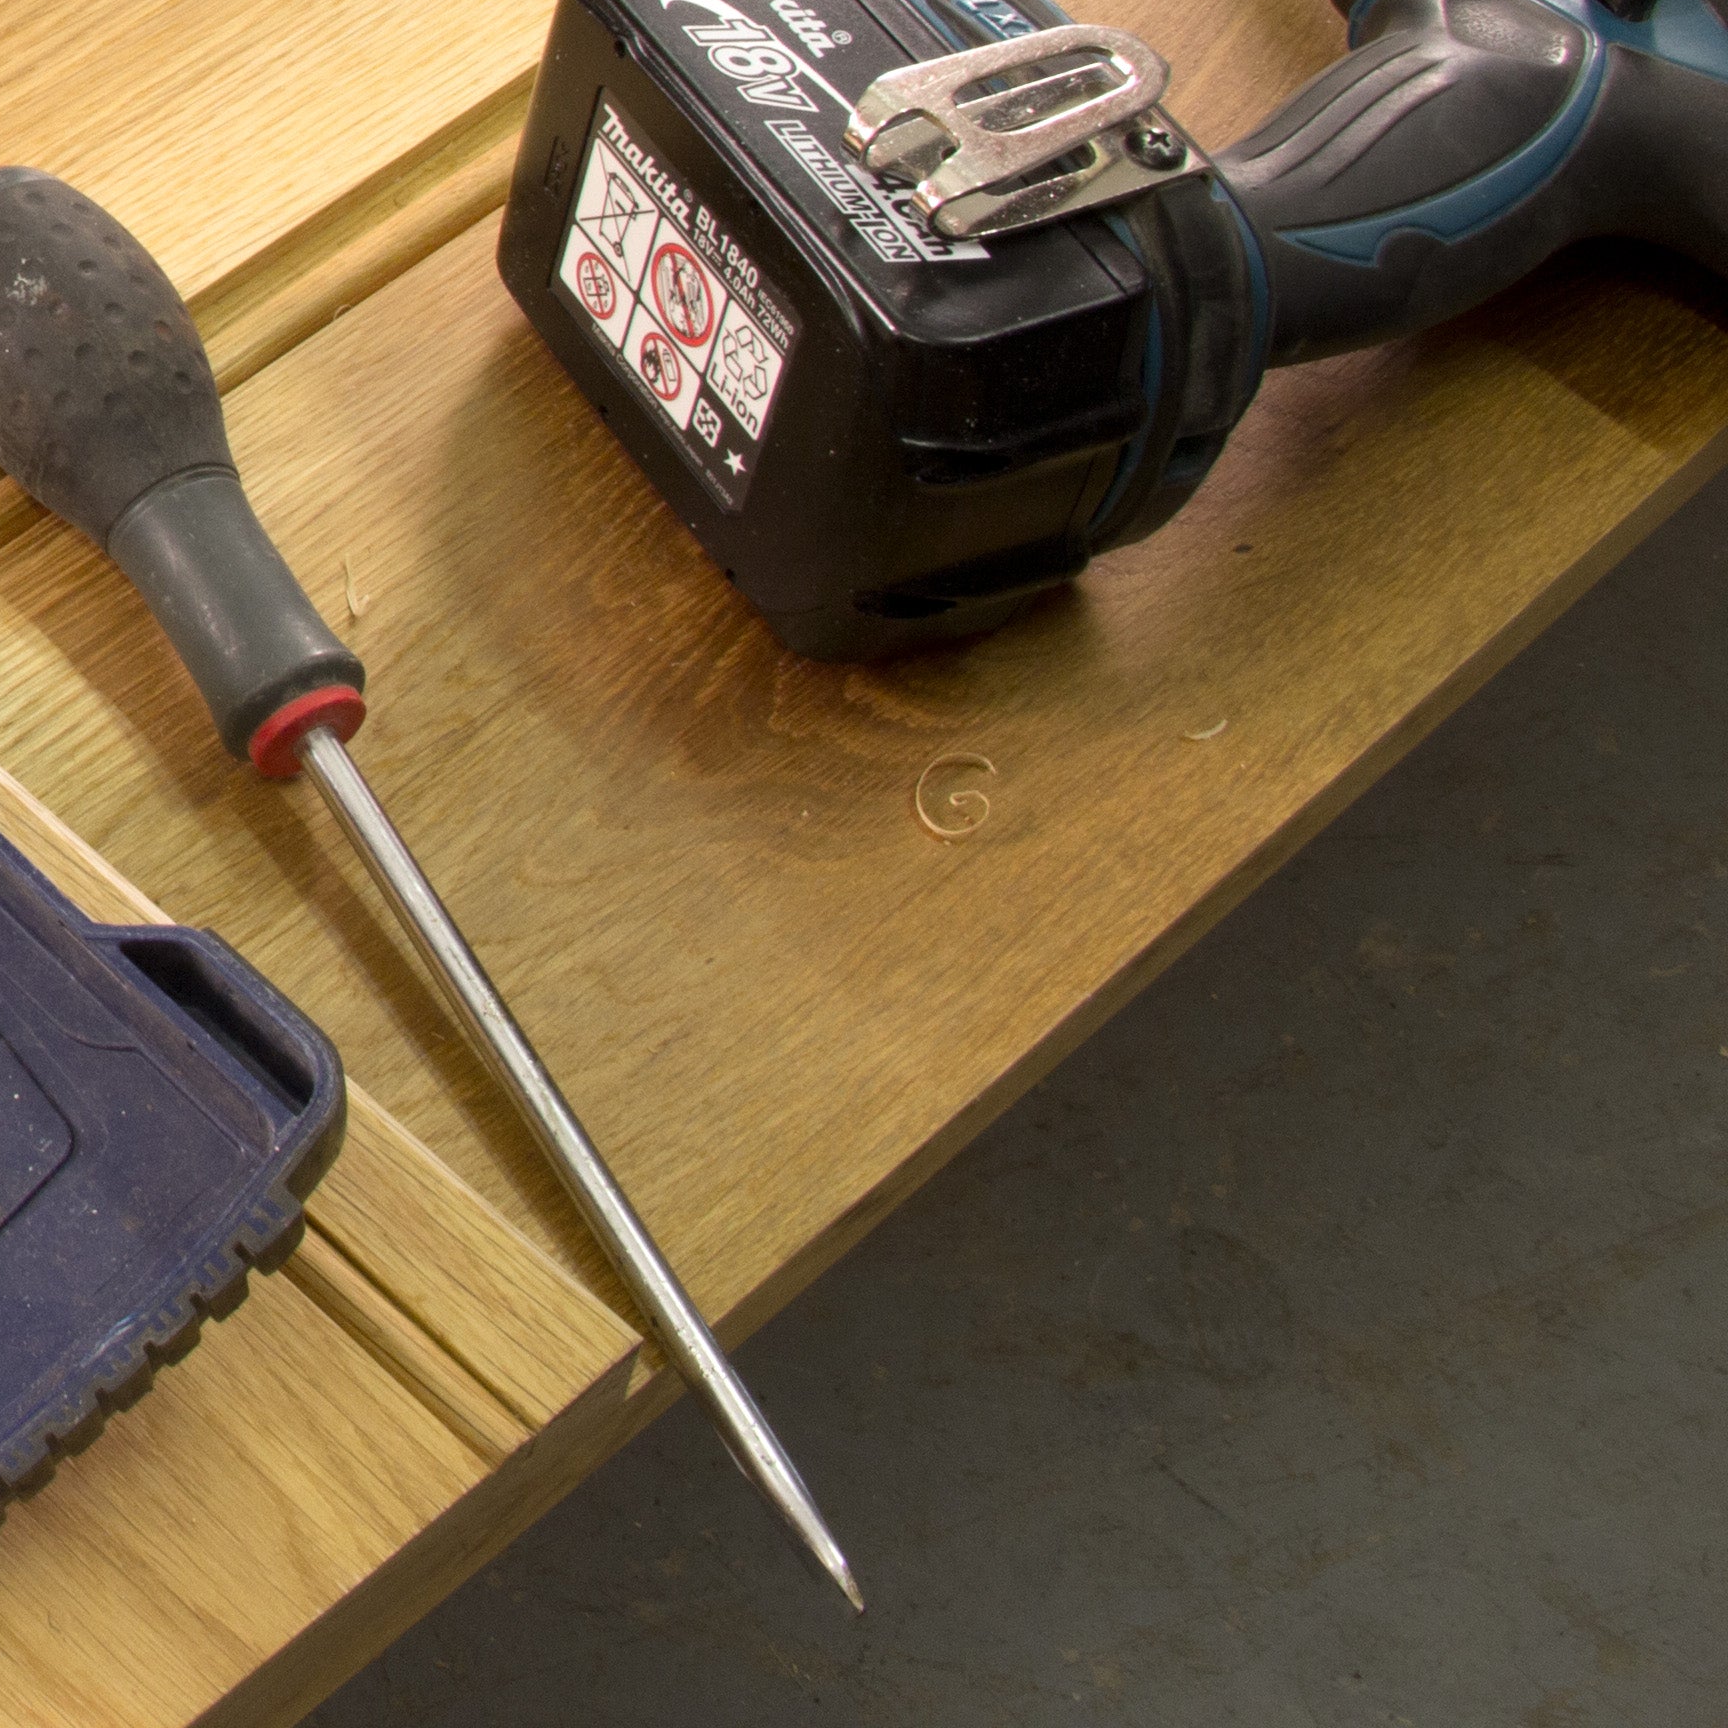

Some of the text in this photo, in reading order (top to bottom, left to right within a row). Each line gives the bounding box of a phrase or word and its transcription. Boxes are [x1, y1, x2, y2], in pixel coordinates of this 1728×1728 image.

[682, 17, 819, 112] 18V
[696, 205, 759, 288] BL1840
[723, 268, 757, 312] 4.0Ah
[756, 300, 790, 348] 72Wh
[710, 361, 759, 433] Li-ion
